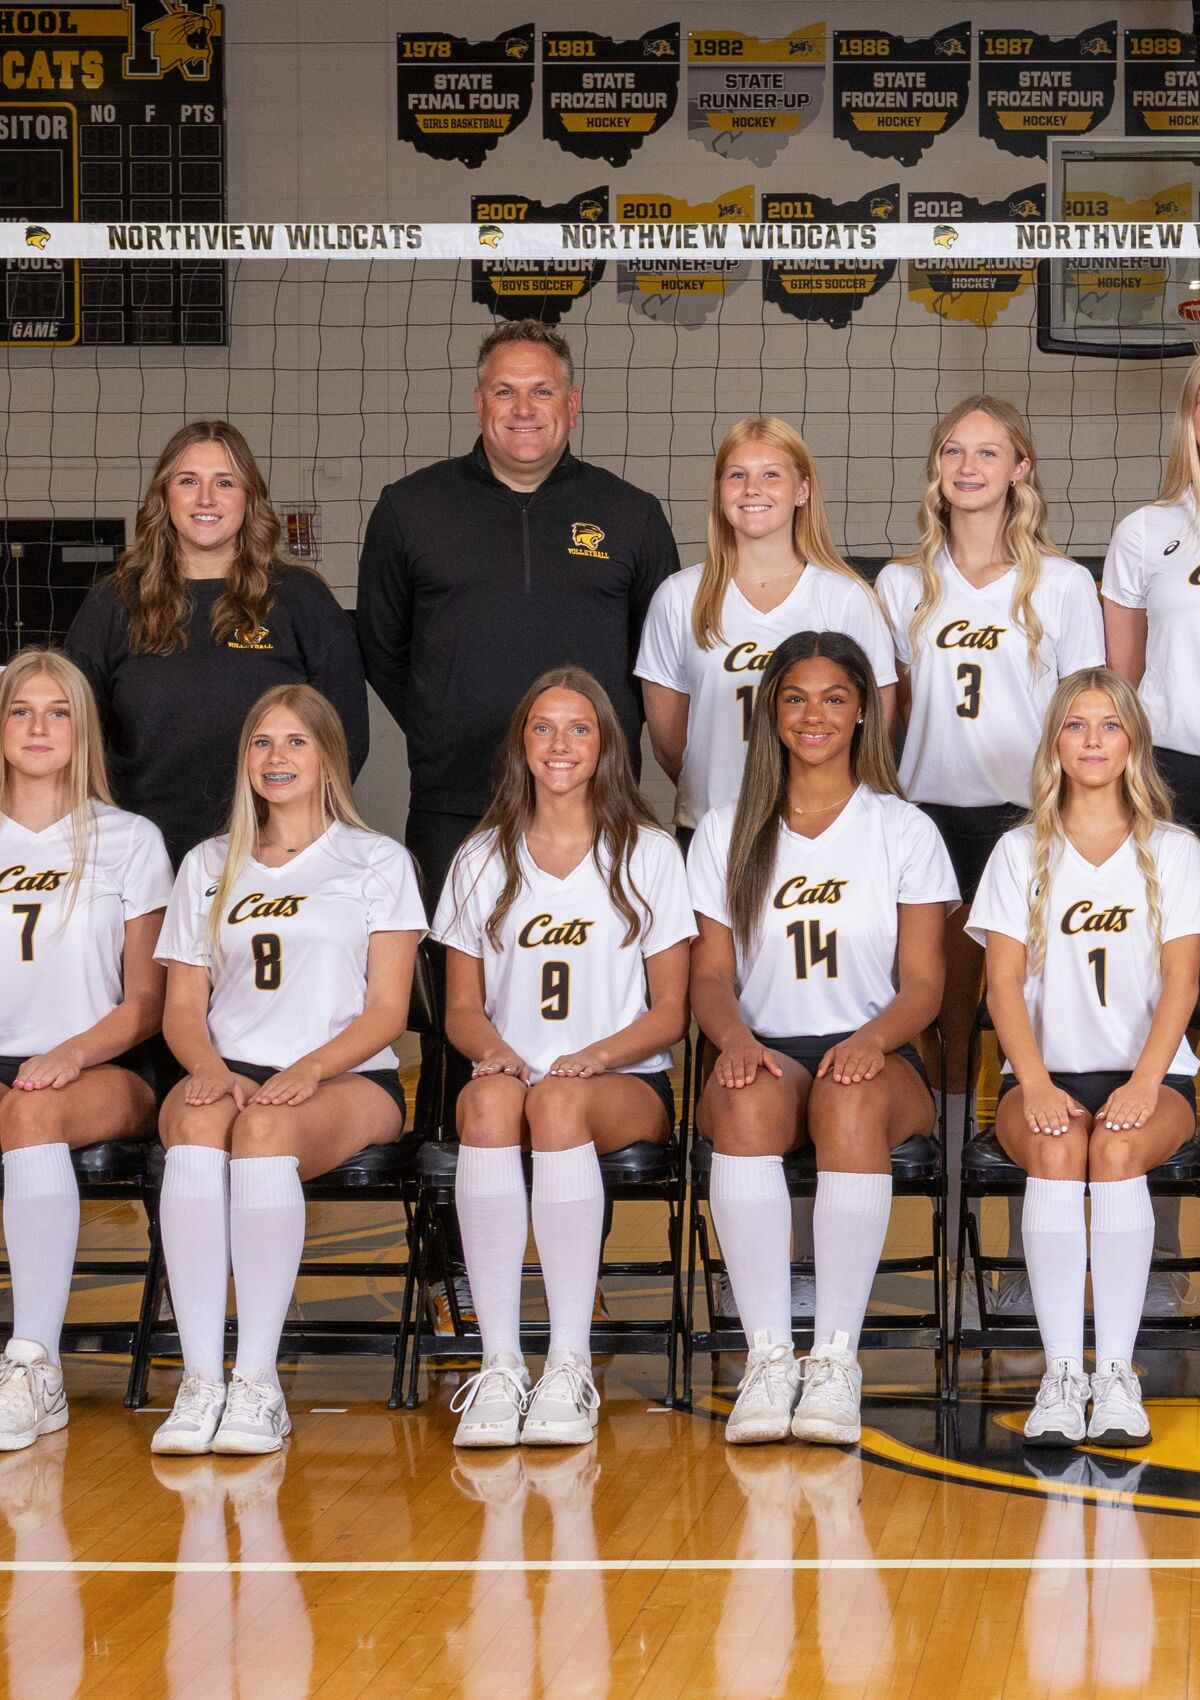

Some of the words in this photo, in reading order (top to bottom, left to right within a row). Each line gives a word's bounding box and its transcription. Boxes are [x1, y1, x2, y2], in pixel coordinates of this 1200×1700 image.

[403, 41, 452, 57] 1978
[549, 40, 596, 56] 1981
[694, 40, 744, 56] 1982
[839, 39, 890, 56] 1986
[985, 38, 1034, 55] 1987
[1130, 38, 1181, 55] 1989
[434, 74, 493, 90] STATE
[582, 73, 636, 89] STATE
[725, 73, 784, 89] STATE
[873, 72, 926, 88] STATE
[1019, 71, 1072, 87] STATE
[408, 94, 465, 110] FINAL
[469, 94, 520, 110] FOUR
[551, 93, 617, 109] FROZEN
[622, 93, 668, 109] FOUR
[698, 93, 811, 109] RUNNER-UP
[842, 92, 908, 108] FROZEN
[913, 92, 958, 108] FOUR
[987, 91, 1053, 107] FROZEN
[1058, 91, 1104, 107] FOUR
[1133, 91, 1199, 107] FROZEN
[91, 105, 116, 122] NO
[145, 105, 156, 122] F
[181, 105, 215, 122] PTS
[1023, 116, 1067, 126] HOCKEY
[423, 118, 449, 129] GIRLS
[451, 118, 504, 129] BASKETBALL
[587, 117, 631, 128] HOCKEY
[732, 117, 776, 128] HOCKEY
[877, 117, 922, 127] HOCKEY
[477, 203, 528, 220] 2007
[623, 203, 672, 219] 2010
[768, 202, 815, 218] 2011
[914, 201, 963, 217] 2012
[107, 225, 274, 250] NORTHVIEW
[283, 224, 422, 250] WILDCATS
[560, 224, 728, 249] NORTHVIEW
[738, 224, 876, 249] WILDCATS
[1015, 224, 1183, 249] NORTHVIEW
[502, 279, 529, 291] BOYS
[532, 279, 573, 291] SOCCER
[661, 279, 704, 290] HOCKEY
[790, 279, 822, 290] GIRLS
[825, 279, 866, 289] SOCCER
[952, 277, 997, 288] HOCKEY
[1097, 277, 1142, 287] HOCKEY
[12, 321, 59, 338] GAME
[567, 547, 610, 559] VOLLEYBALL
[936, 619, 1009, 651] Cats
[723, 641, 777, 673] Cat
[955, 662, 982, 719] 3
[0, 864, 70, 893] Cats
[773, 875, 850, 909] Cats
[227, 893, 308, 924] Cats
[1060, 900, 1137, 935] Cats
[12, 902, 42, 961] 7
[518, 913, 598, 948] Cats
[786, 919, 838, 979] 14
[252, 933, 282, 991] 8
[1088, 947, 1107, 1007] 1
[541, 960, 570, 1020] 9
